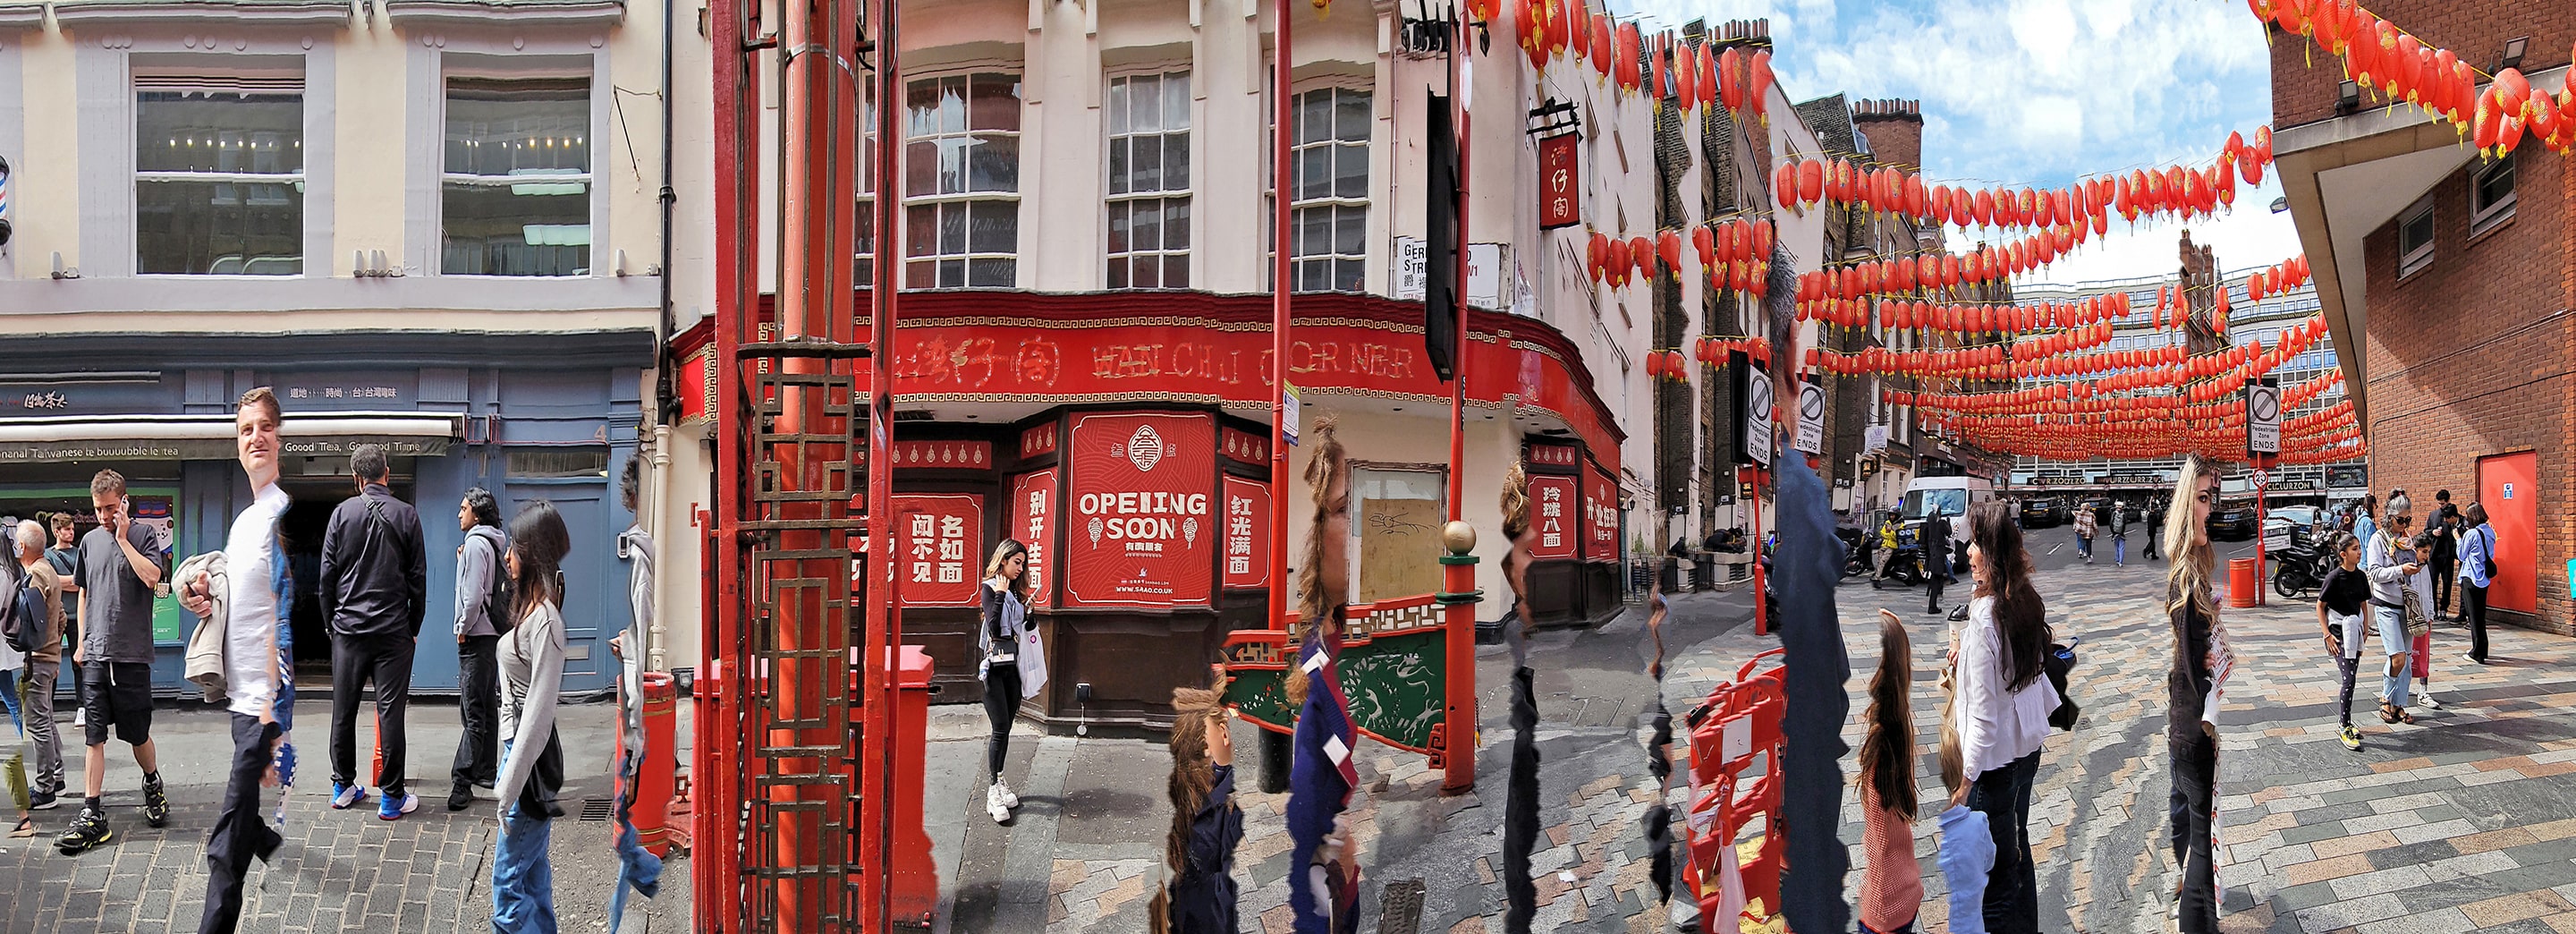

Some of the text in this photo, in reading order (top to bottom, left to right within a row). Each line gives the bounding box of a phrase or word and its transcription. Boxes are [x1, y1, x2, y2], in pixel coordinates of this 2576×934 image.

[594, 424, 606, 441] 4
[1800, 423, 1821, 435] edestrian
[1803, 430, 1814, 438] Zone
[1754, 433, 1765, 446] Zone
[1797, 438, 1818, 451] ENDS
[2253, 440, 2275, 449] ENDS
[1750, 442, 1768, 461] ENDS
[1106, 517, 1175, 540] SOON
[1229, 495, 1253, 574] 红光满面
